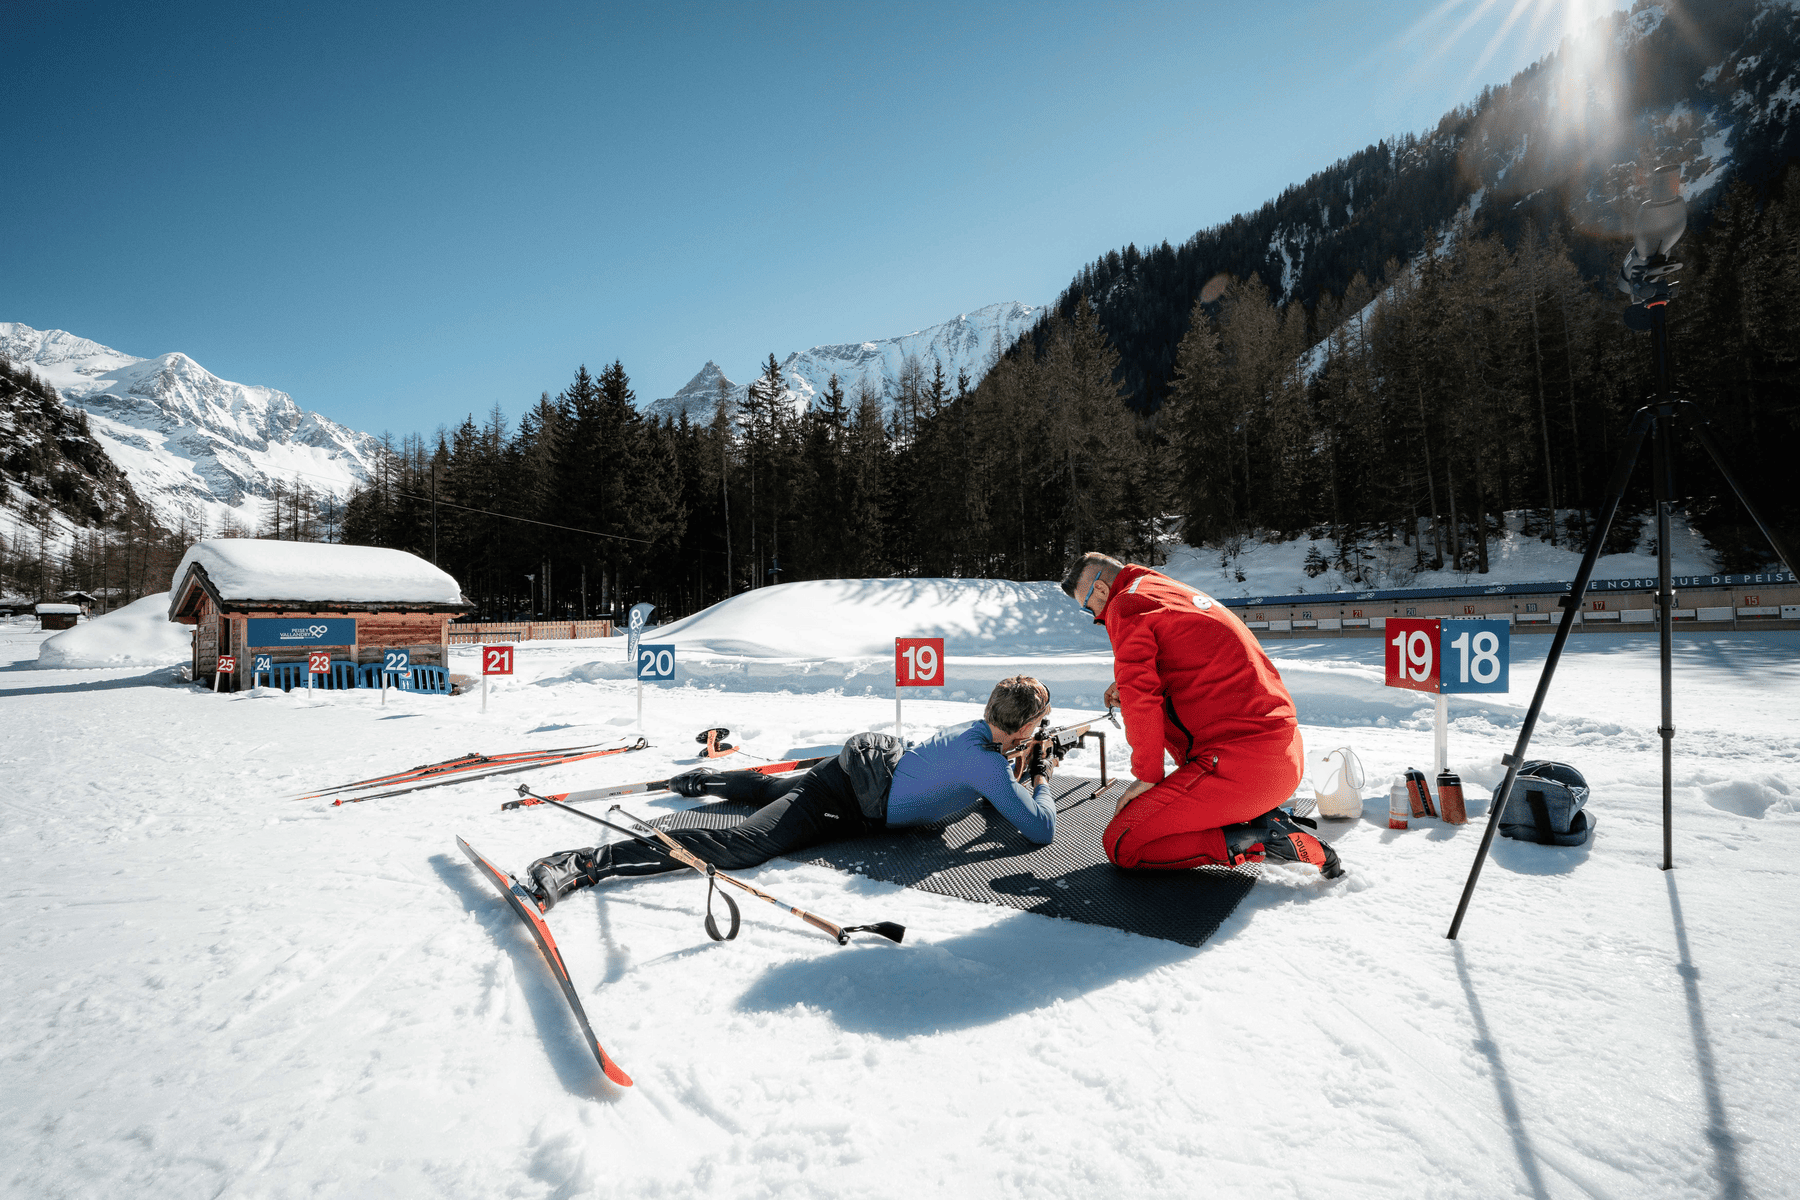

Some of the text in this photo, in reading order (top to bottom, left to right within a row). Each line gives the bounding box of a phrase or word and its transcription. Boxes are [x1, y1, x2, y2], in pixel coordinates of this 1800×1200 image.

[1566, 581, 1598, 591] SE
[1608, 577, 1700, 589] NORDUE
[1711, 575, 1732, 585] DE
[1595, 601, 1604, 609] 17
[1747, 596, 1758, 605] 15
[1303, 611, 1311, 619] 22
[1354, 610, 1362, 618] 21
[1407, 608, 1416, 616] 20
[1465, 606, 1474, 614] 19
[1527, 604, 1537, 612] 18
[385, 653, 408, 671] 22
[487, 650, 509, 671] 21
[640, 650, 674, 676] 20
[902, 645, 938, 680] 19
[1392, 630, 1433, 682] 19
[1451, 631, 1501, 684] 18
[218, 659, 234, 671] 25
[256, 657, 271, 671] 24
[310, 656, 330, 671] 23
[1294, 834, 1311, 864] SIGNOL
